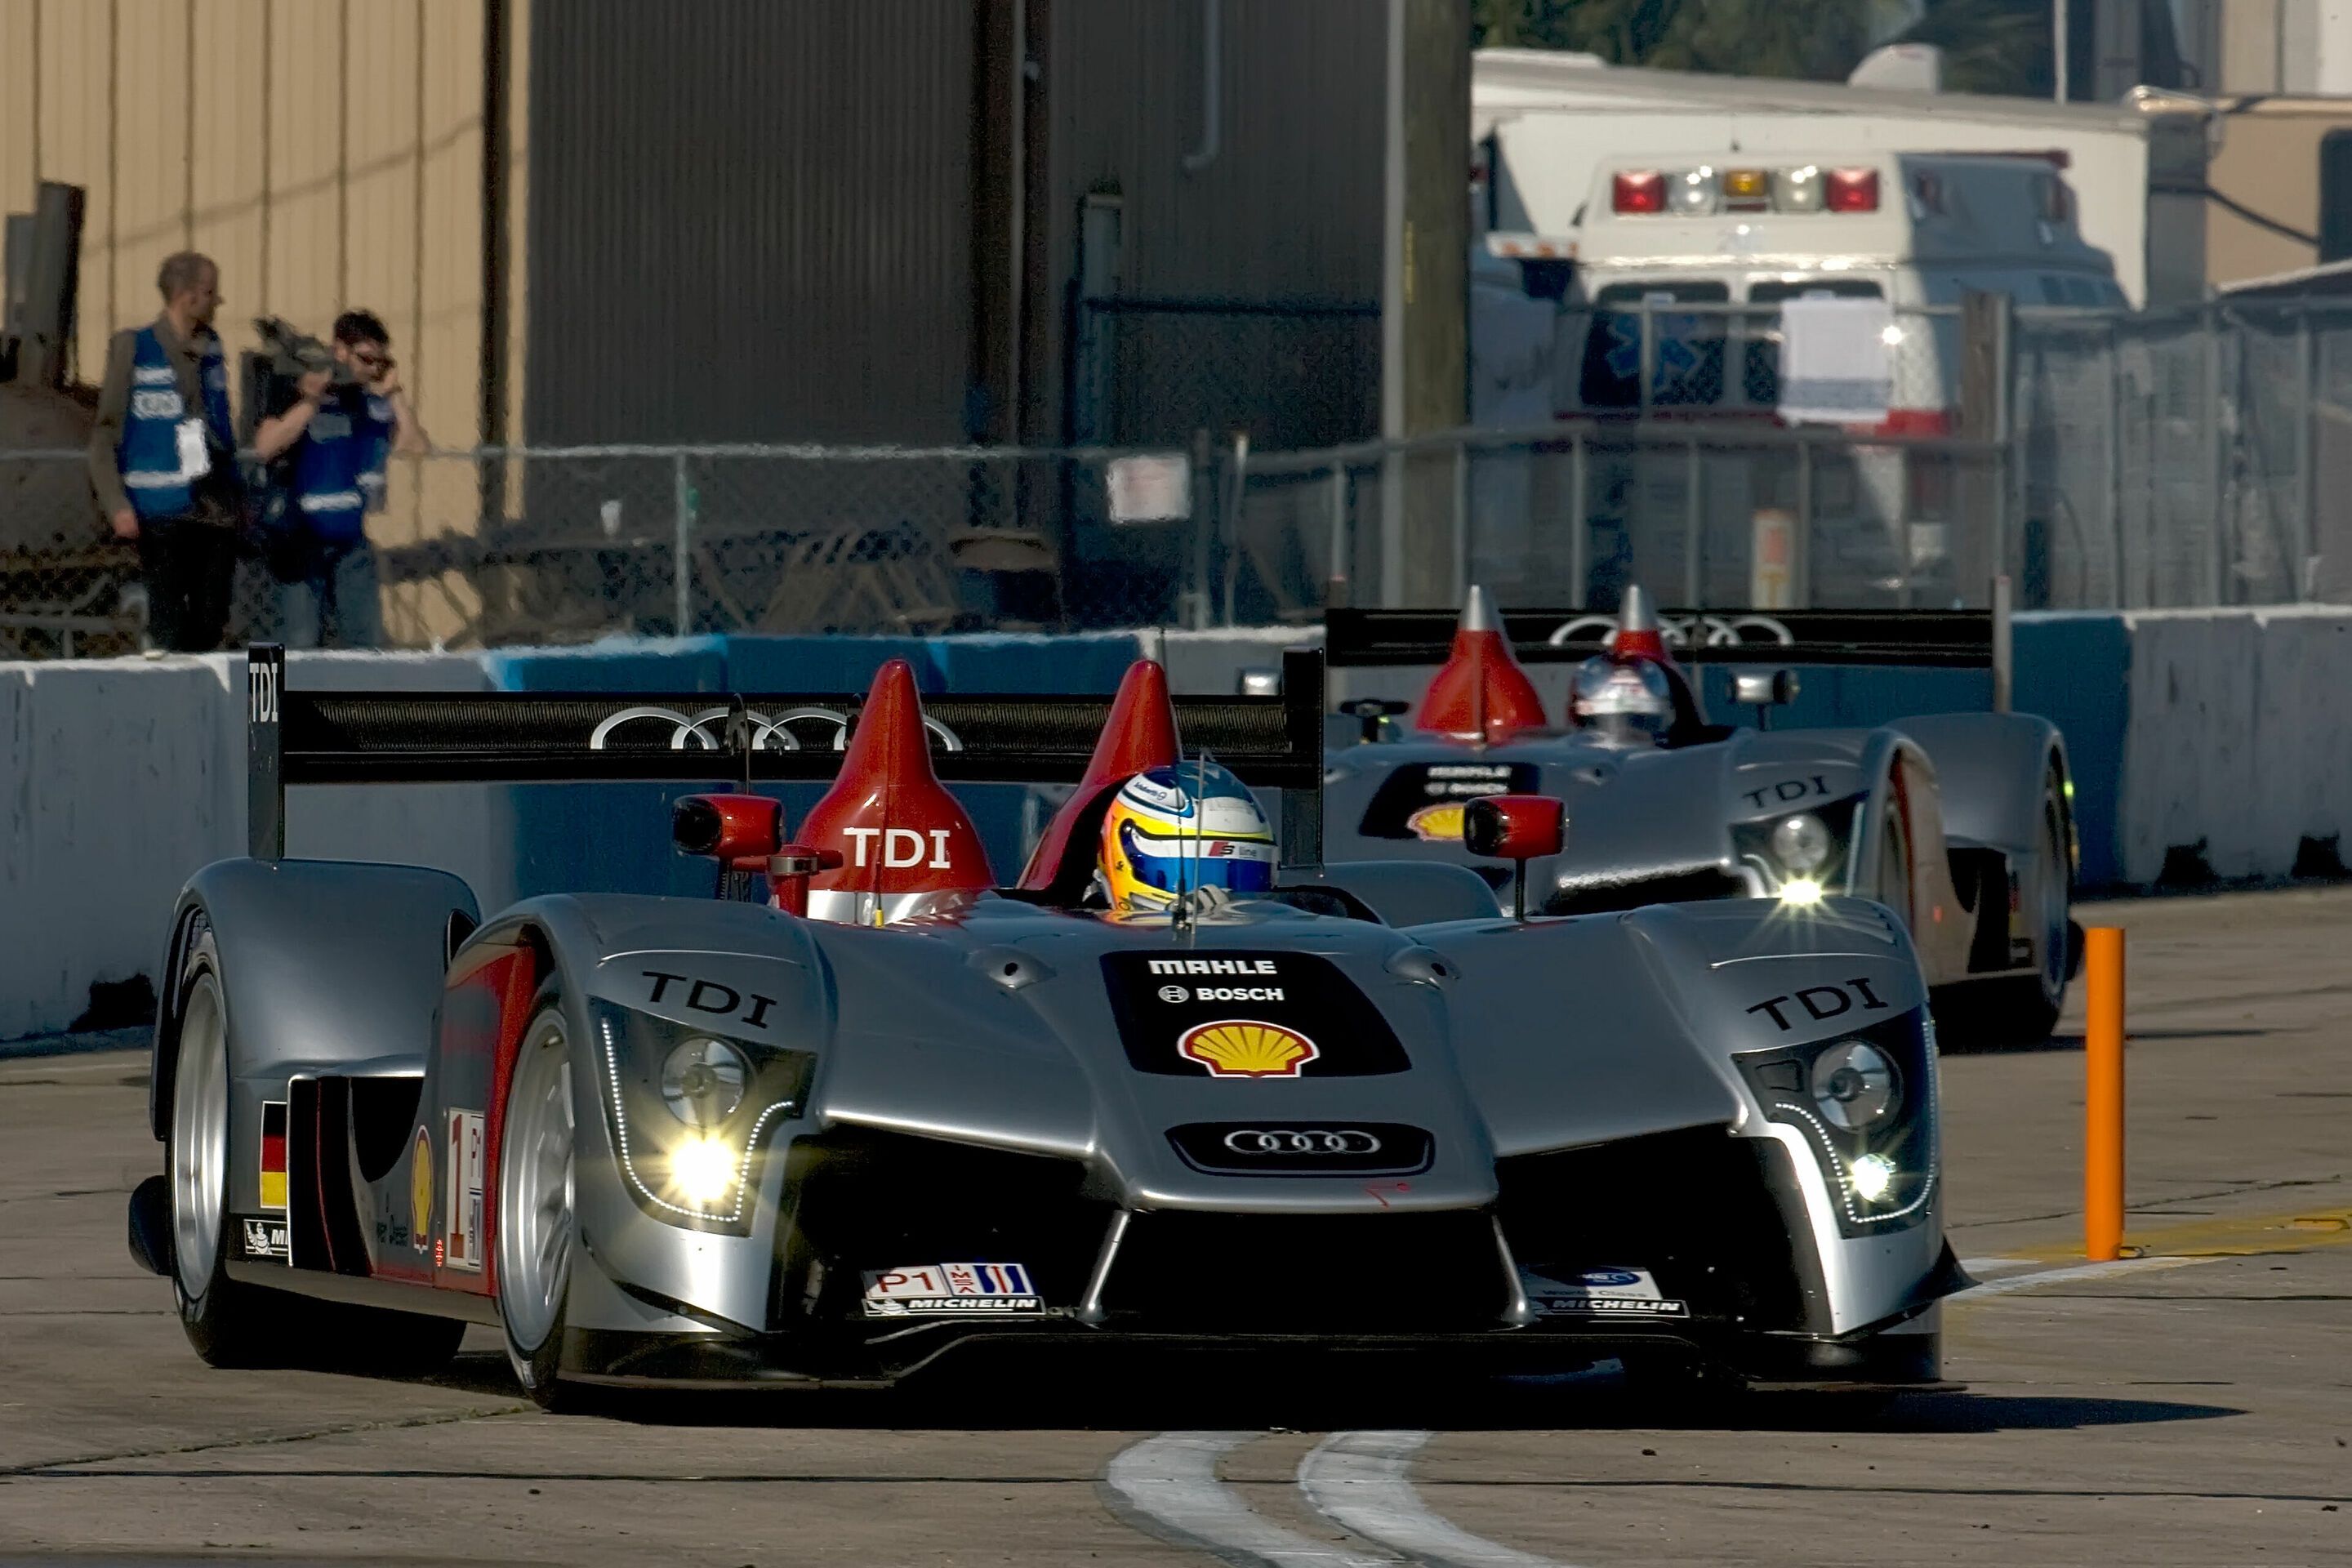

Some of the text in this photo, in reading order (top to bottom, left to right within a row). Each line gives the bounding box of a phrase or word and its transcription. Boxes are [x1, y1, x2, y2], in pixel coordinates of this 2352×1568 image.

[249, 662, 278, 722] TDI
[1740, 775, 1830, 808] TDI
[843, 827, 951, 869] TDI
[1148, 960, 1277, 974] MAHLE
[642, 970, 777, 1029] TDI
[1196, 987, 1285, 1001] BOSCH
[1745, 977, 1889, 1031] TDI
[450, 1114, 465, 1258] 1
[875, 1272, 935, 1293] P1
[908, 1298, 1037, 1308] MICHELIN
[1552, 1300, 1681, 1311] MICHELIN
